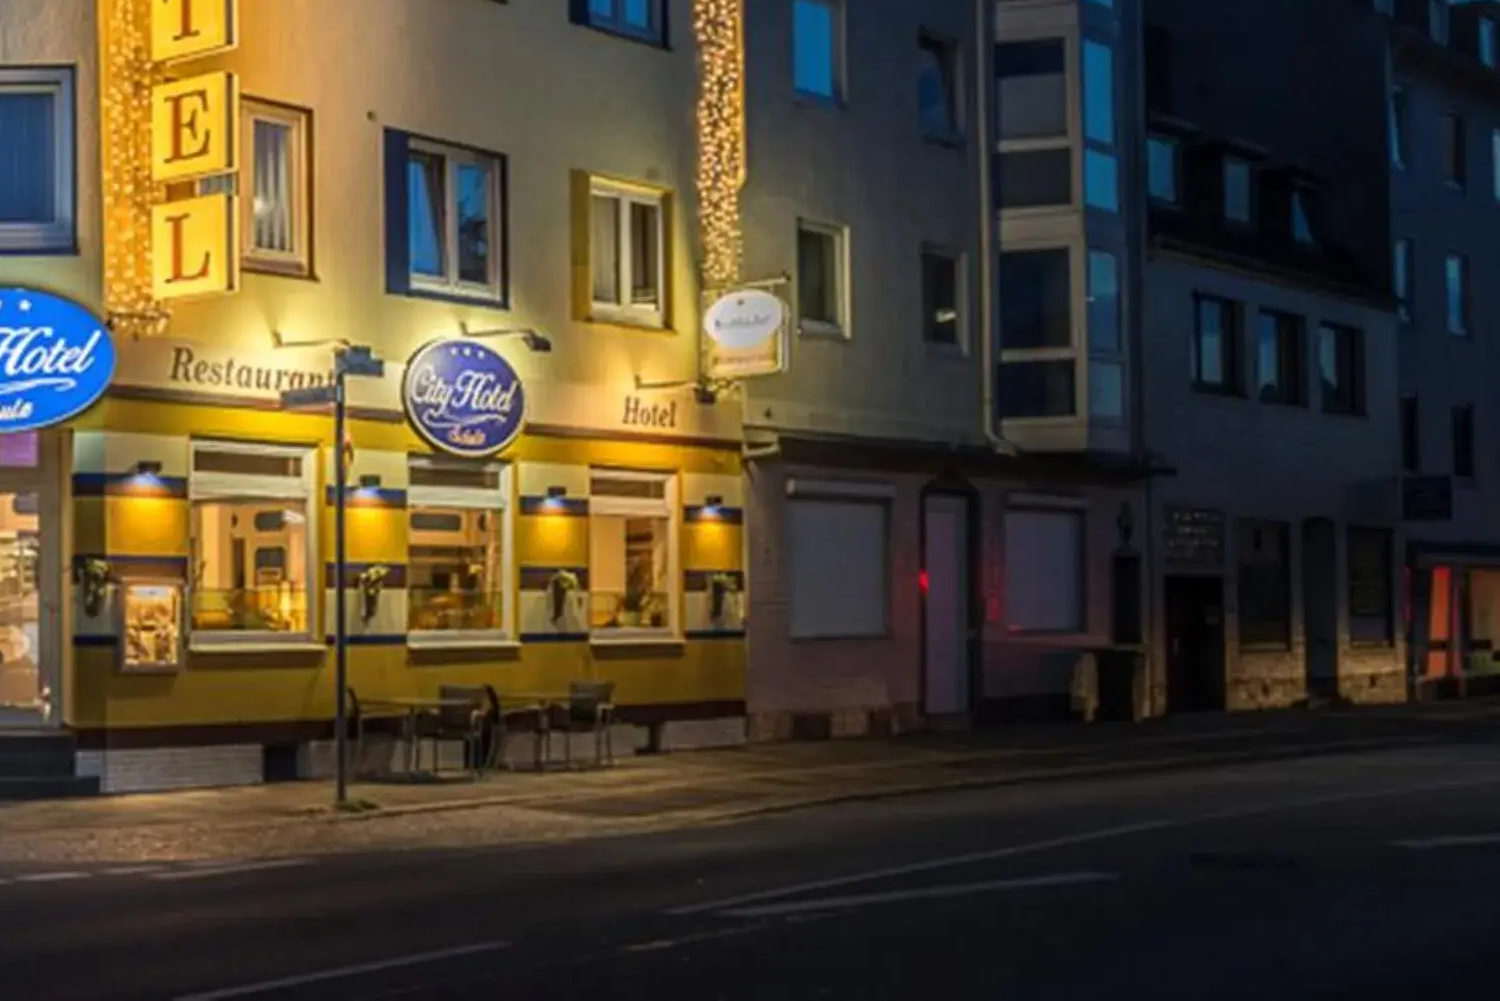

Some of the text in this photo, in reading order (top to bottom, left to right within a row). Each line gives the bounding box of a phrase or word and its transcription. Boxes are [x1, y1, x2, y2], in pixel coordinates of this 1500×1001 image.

[170, 346, 334, 390] Restaurant
[411, 364, 518, 417] City Hotel
[622, 395, 677, 428] Hotel
